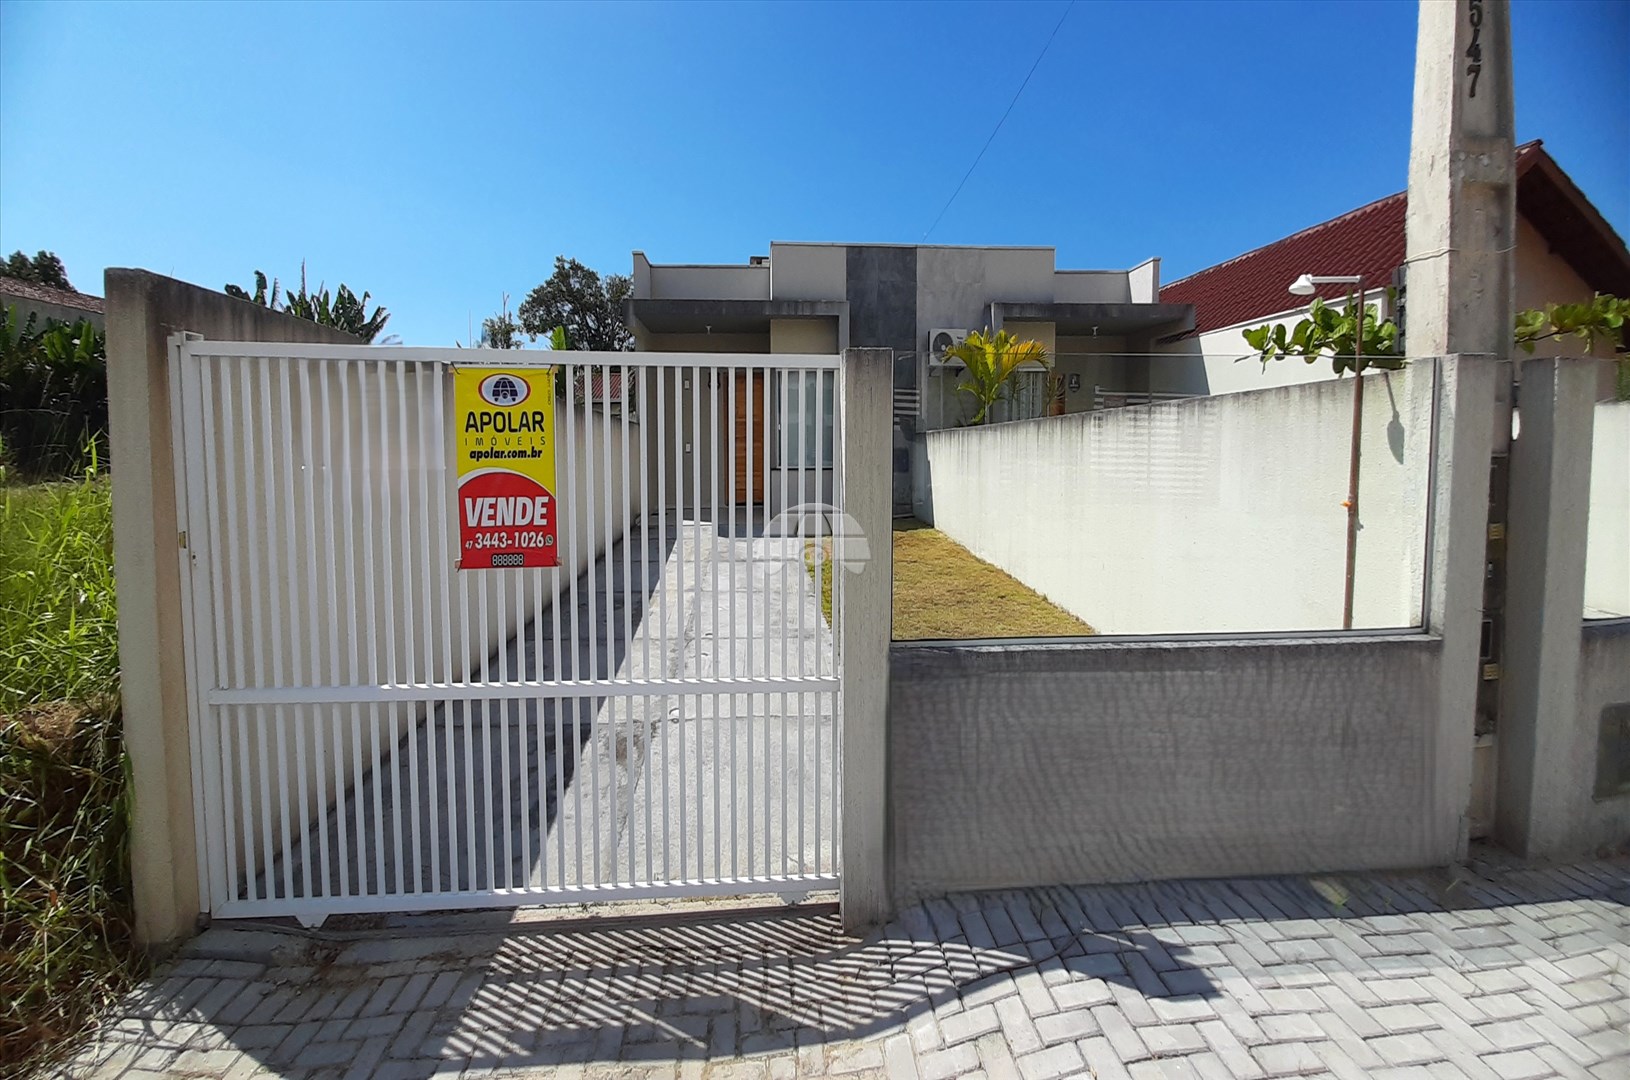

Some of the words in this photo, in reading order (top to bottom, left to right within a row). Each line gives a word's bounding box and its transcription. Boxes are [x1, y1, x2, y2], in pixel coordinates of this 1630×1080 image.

[465, 411, 545, 433] APOLAR
[465, 435, 546, 446] IMÓVEIS
[469, 446, 542, 462] apolar.com.br
[464, 496, 549, 527] VENDE
[475, 531, 545, 549] 3443-1026
